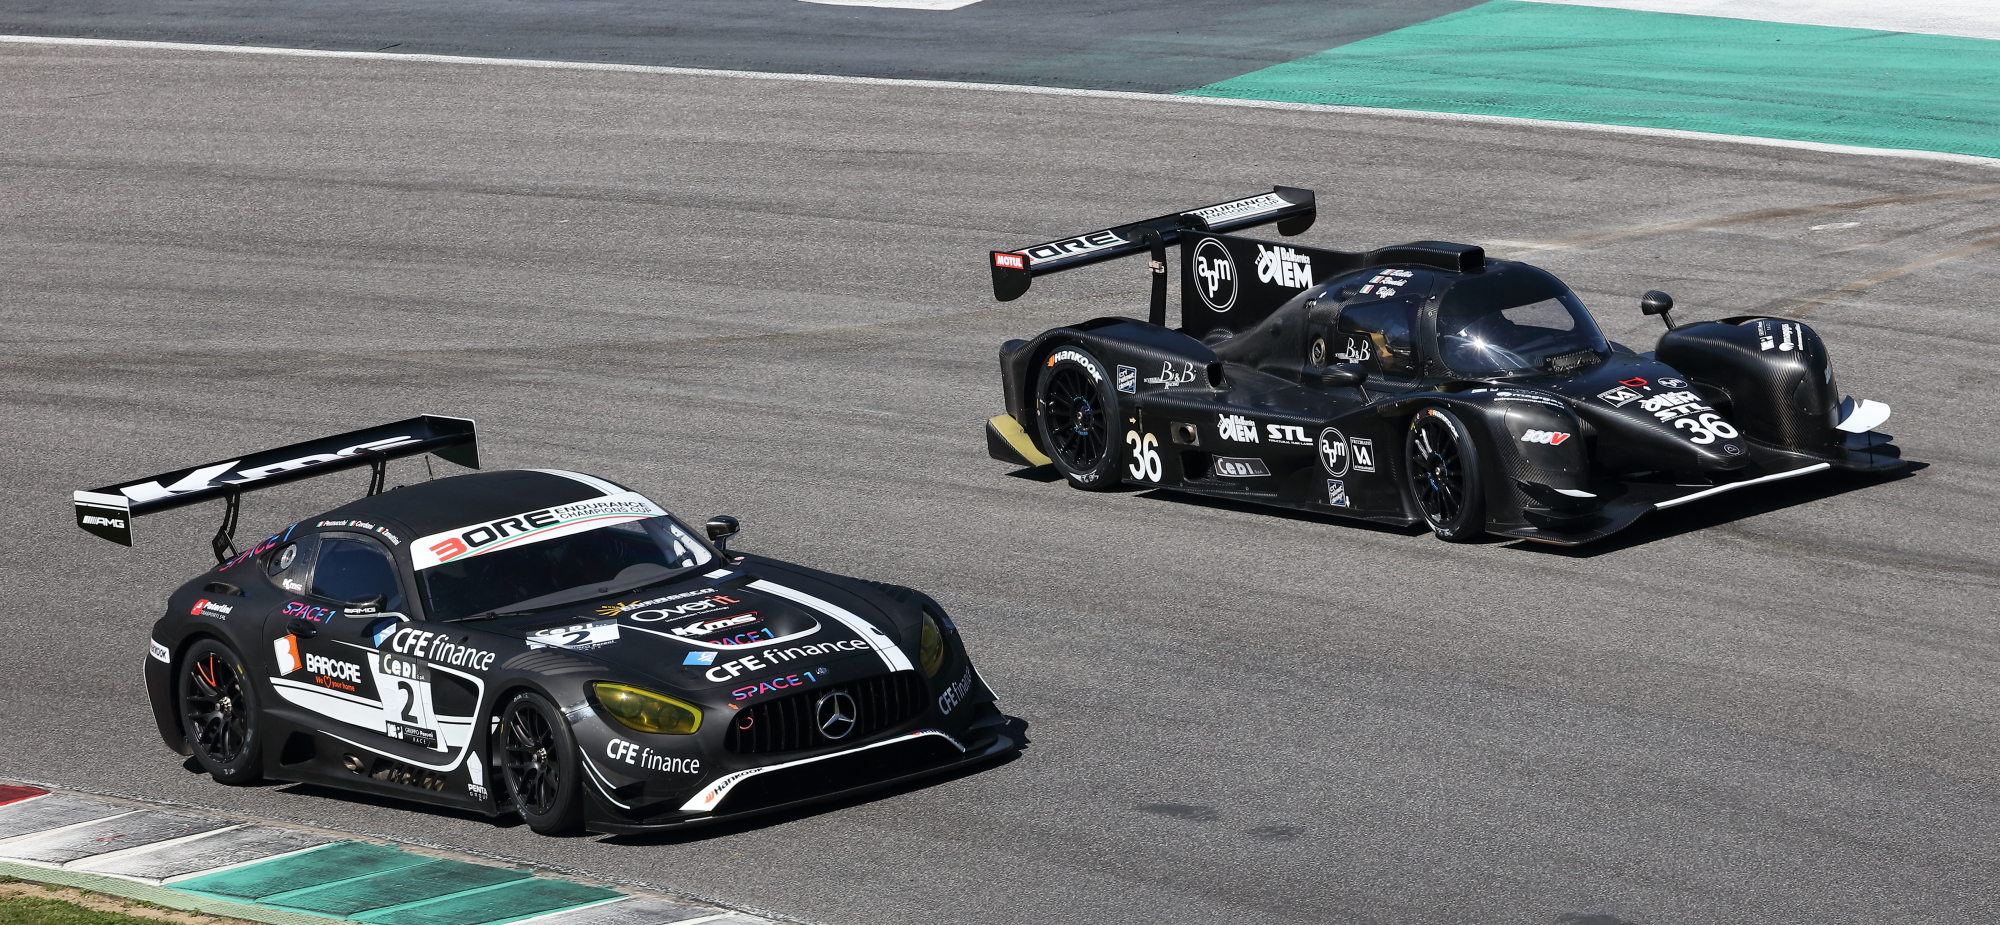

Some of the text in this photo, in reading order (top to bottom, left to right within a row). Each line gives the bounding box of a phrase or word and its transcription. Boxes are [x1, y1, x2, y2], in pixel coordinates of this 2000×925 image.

[1193, 194, 1275, 217] NDURANCE
[997, 255, 1023, 267] MOTUL
[1266, 424, 1313, 442] STL
[1520, 428, 1571, 446] 300V
[1674, 412, 1739, 445] 36
[1126, 430, 1162, 483] 36
[554, 501, 647, 515] ENDURANCE
[559, 506, 652, 519] CHAMPIONS CUP
[95, 516, 125, 529] AMG
[428, 509, 560, 563] 3ORE
[282, 601, 337, 624] SPACE 1
[392, 628, 496, 671] CFE finance
[562, 630, 593, 646] 2
[305, 652, 362, 684] BARCORE
[705, 638, 870, 683] CFE finance
[731, 671, 817, 701] SPACE 1
[397, 680, 419, 725] 2
[606, 738, 700, 774] CFE finance
[467, 783, 488, 796] PENTA
